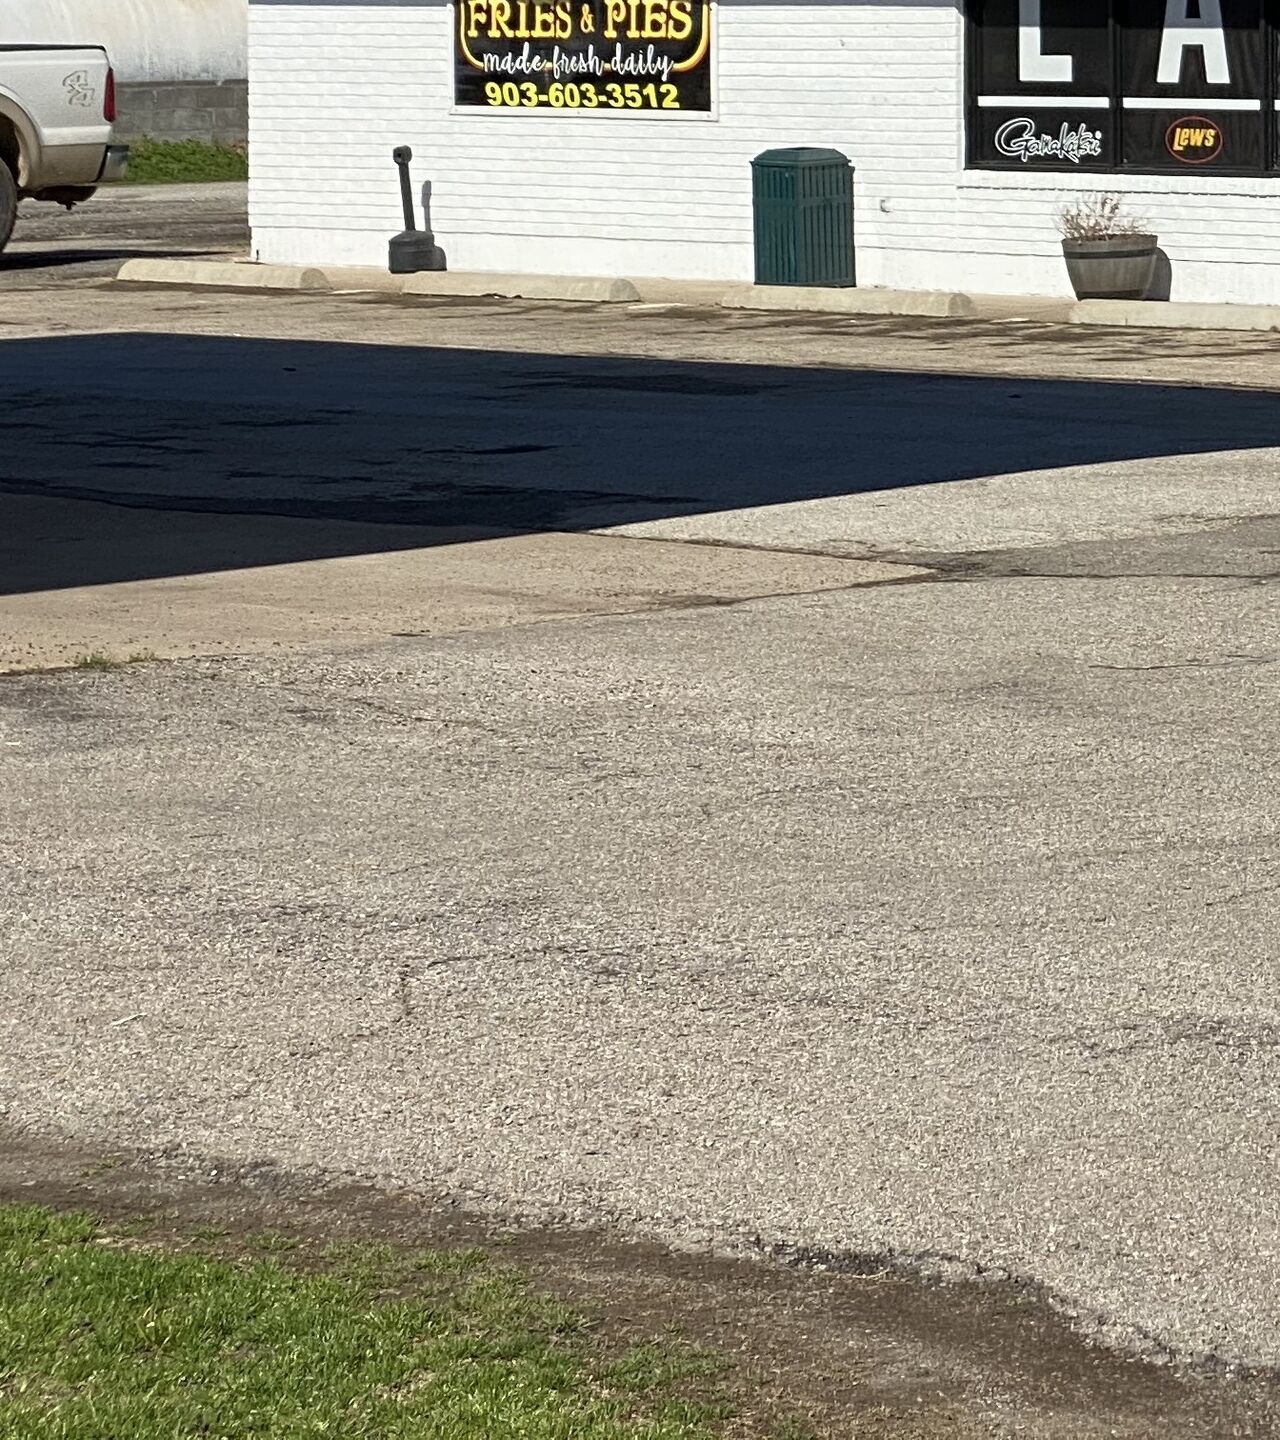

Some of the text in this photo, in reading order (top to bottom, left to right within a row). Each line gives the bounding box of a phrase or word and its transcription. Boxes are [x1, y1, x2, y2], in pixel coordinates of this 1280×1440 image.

[580, 3, 595, 34] &
[483, 42, 674, 81] made fresh daily
[484, 81, 681, 109] 903-603-3512
